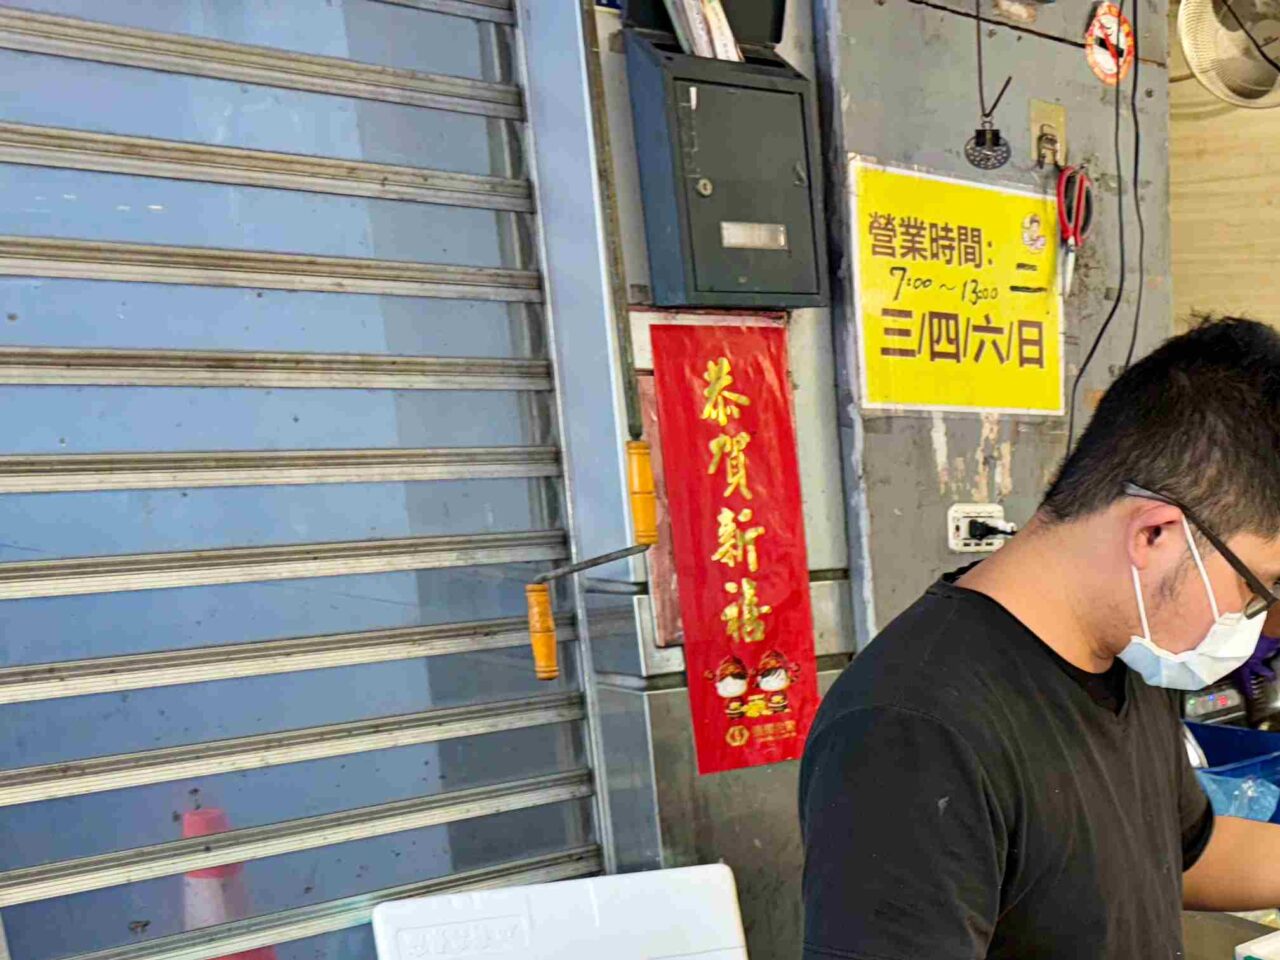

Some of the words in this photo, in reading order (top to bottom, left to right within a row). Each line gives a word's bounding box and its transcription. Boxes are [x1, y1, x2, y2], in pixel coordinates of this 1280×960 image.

[868, 211, 994, 269] 營業時間:
[880, 307, 1044, 369] 三/四/六/日
[701, 357, 772, 643] 恭賀新禧
